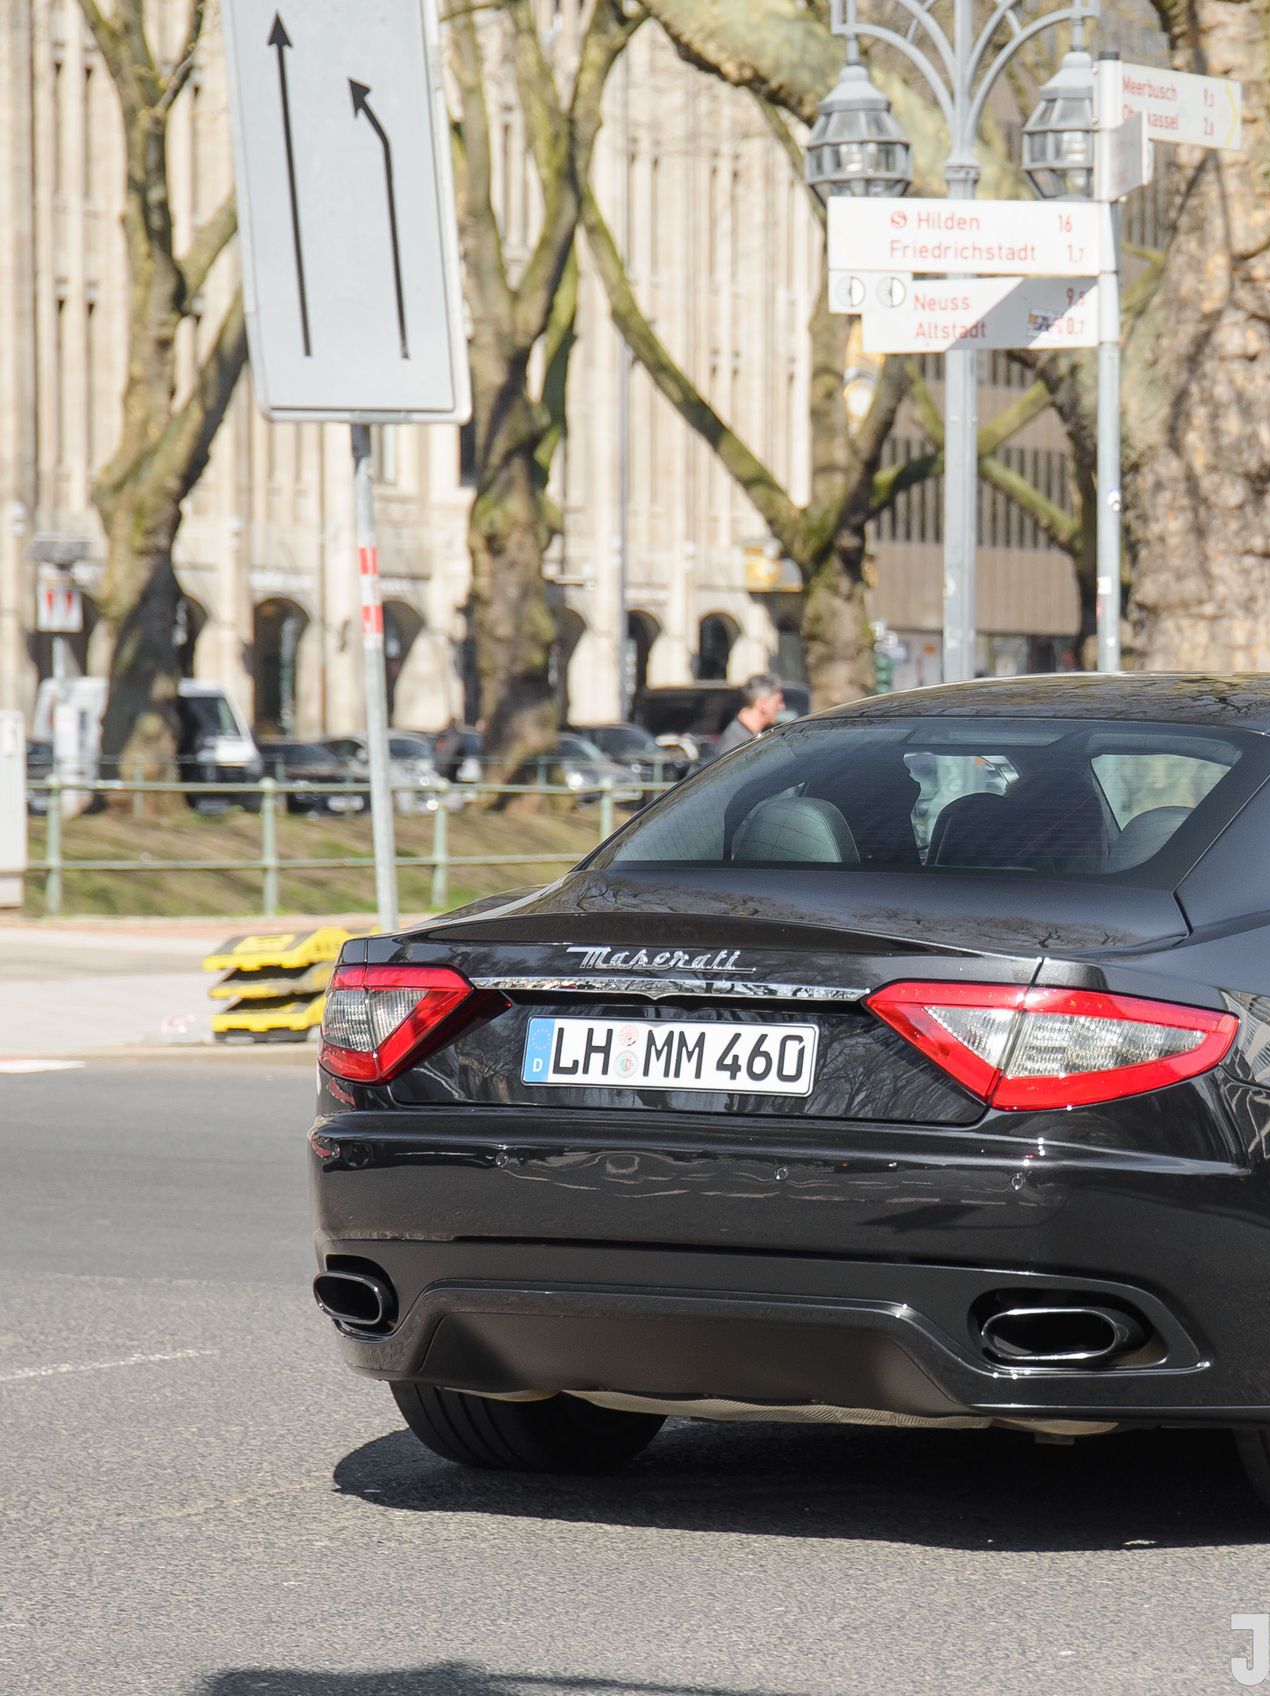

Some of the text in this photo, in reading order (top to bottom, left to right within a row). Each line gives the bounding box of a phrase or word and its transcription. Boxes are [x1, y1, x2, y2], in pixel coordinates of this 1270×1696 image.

[1122, 75, 1177, 101] Meerbusch
[917, 212, 980, 231] Hilden
[1058, 214, 1073, 233] 16
[890, 240, 1036, 262] Friedrichstadt
[914, 295, 970, 312] Neuss
[915, 322, 986, 340] Altstadt
[566, 946, 757, 973] Maserati
[532, 1027, 805, 1082] D LH MM 460
